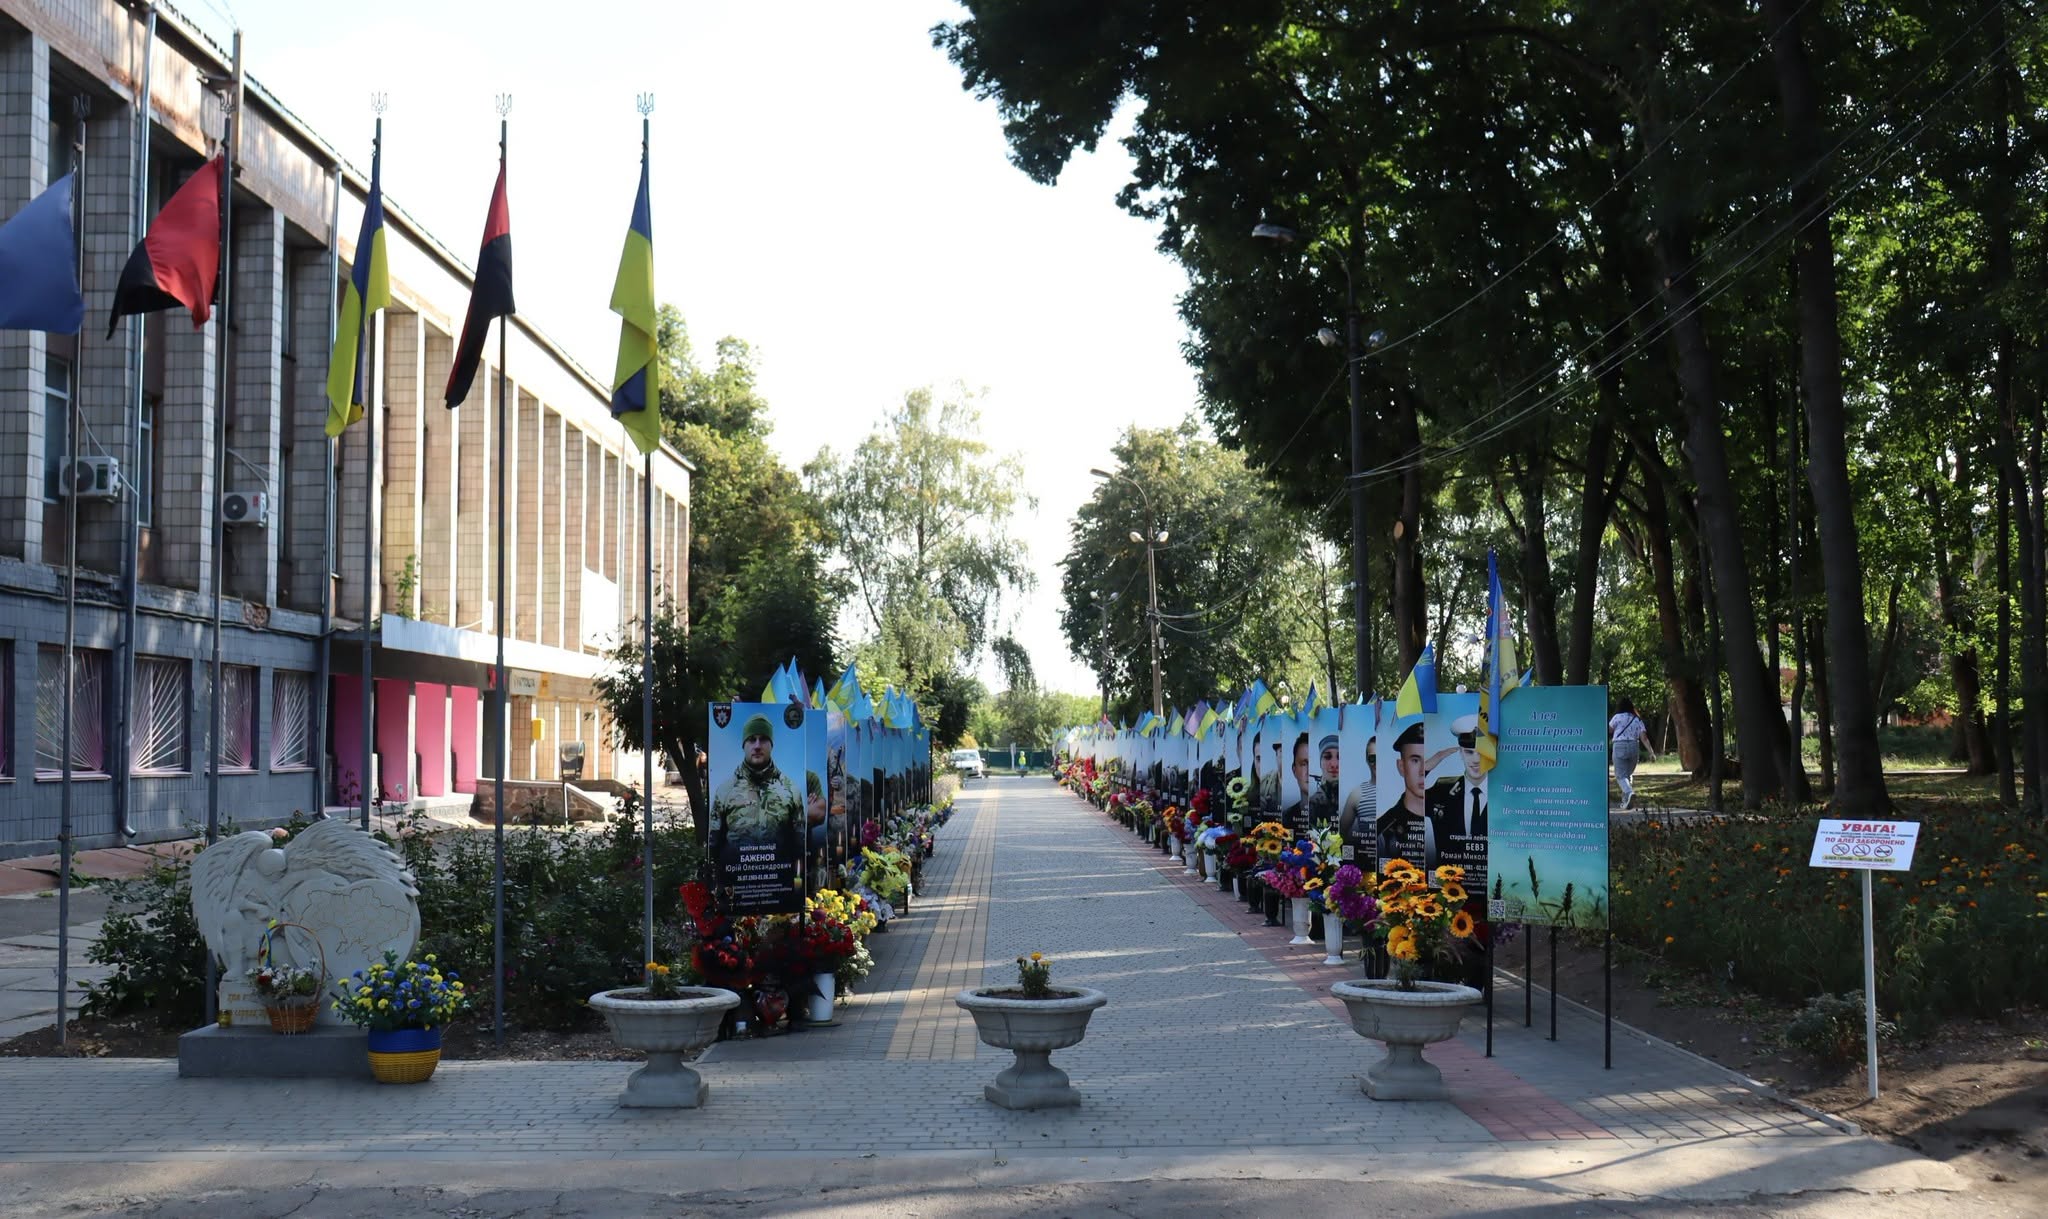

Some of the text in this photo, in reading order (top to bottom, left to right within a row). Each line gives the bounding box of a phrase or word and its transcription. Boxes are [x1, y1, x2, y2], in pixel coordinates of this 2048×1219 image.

[1530, 710, 1558, 720] Алея
[1507, 726, 1583, 738] Слави Героям
[1498, 741, 1604, 753] онастирищенської
[1521, 756, 1569, 769] громади
[1841, 823, 1896, 834] УВАГА!
[1465, 843, 1484, 851] БЕВЗ
[1855, 838, 1905, 846] ЗАБОРОНЕНО
[740, 853, 775, 862] БАЖЕНОВ
[725, 863, 792, 872] Юрій Олександрович
